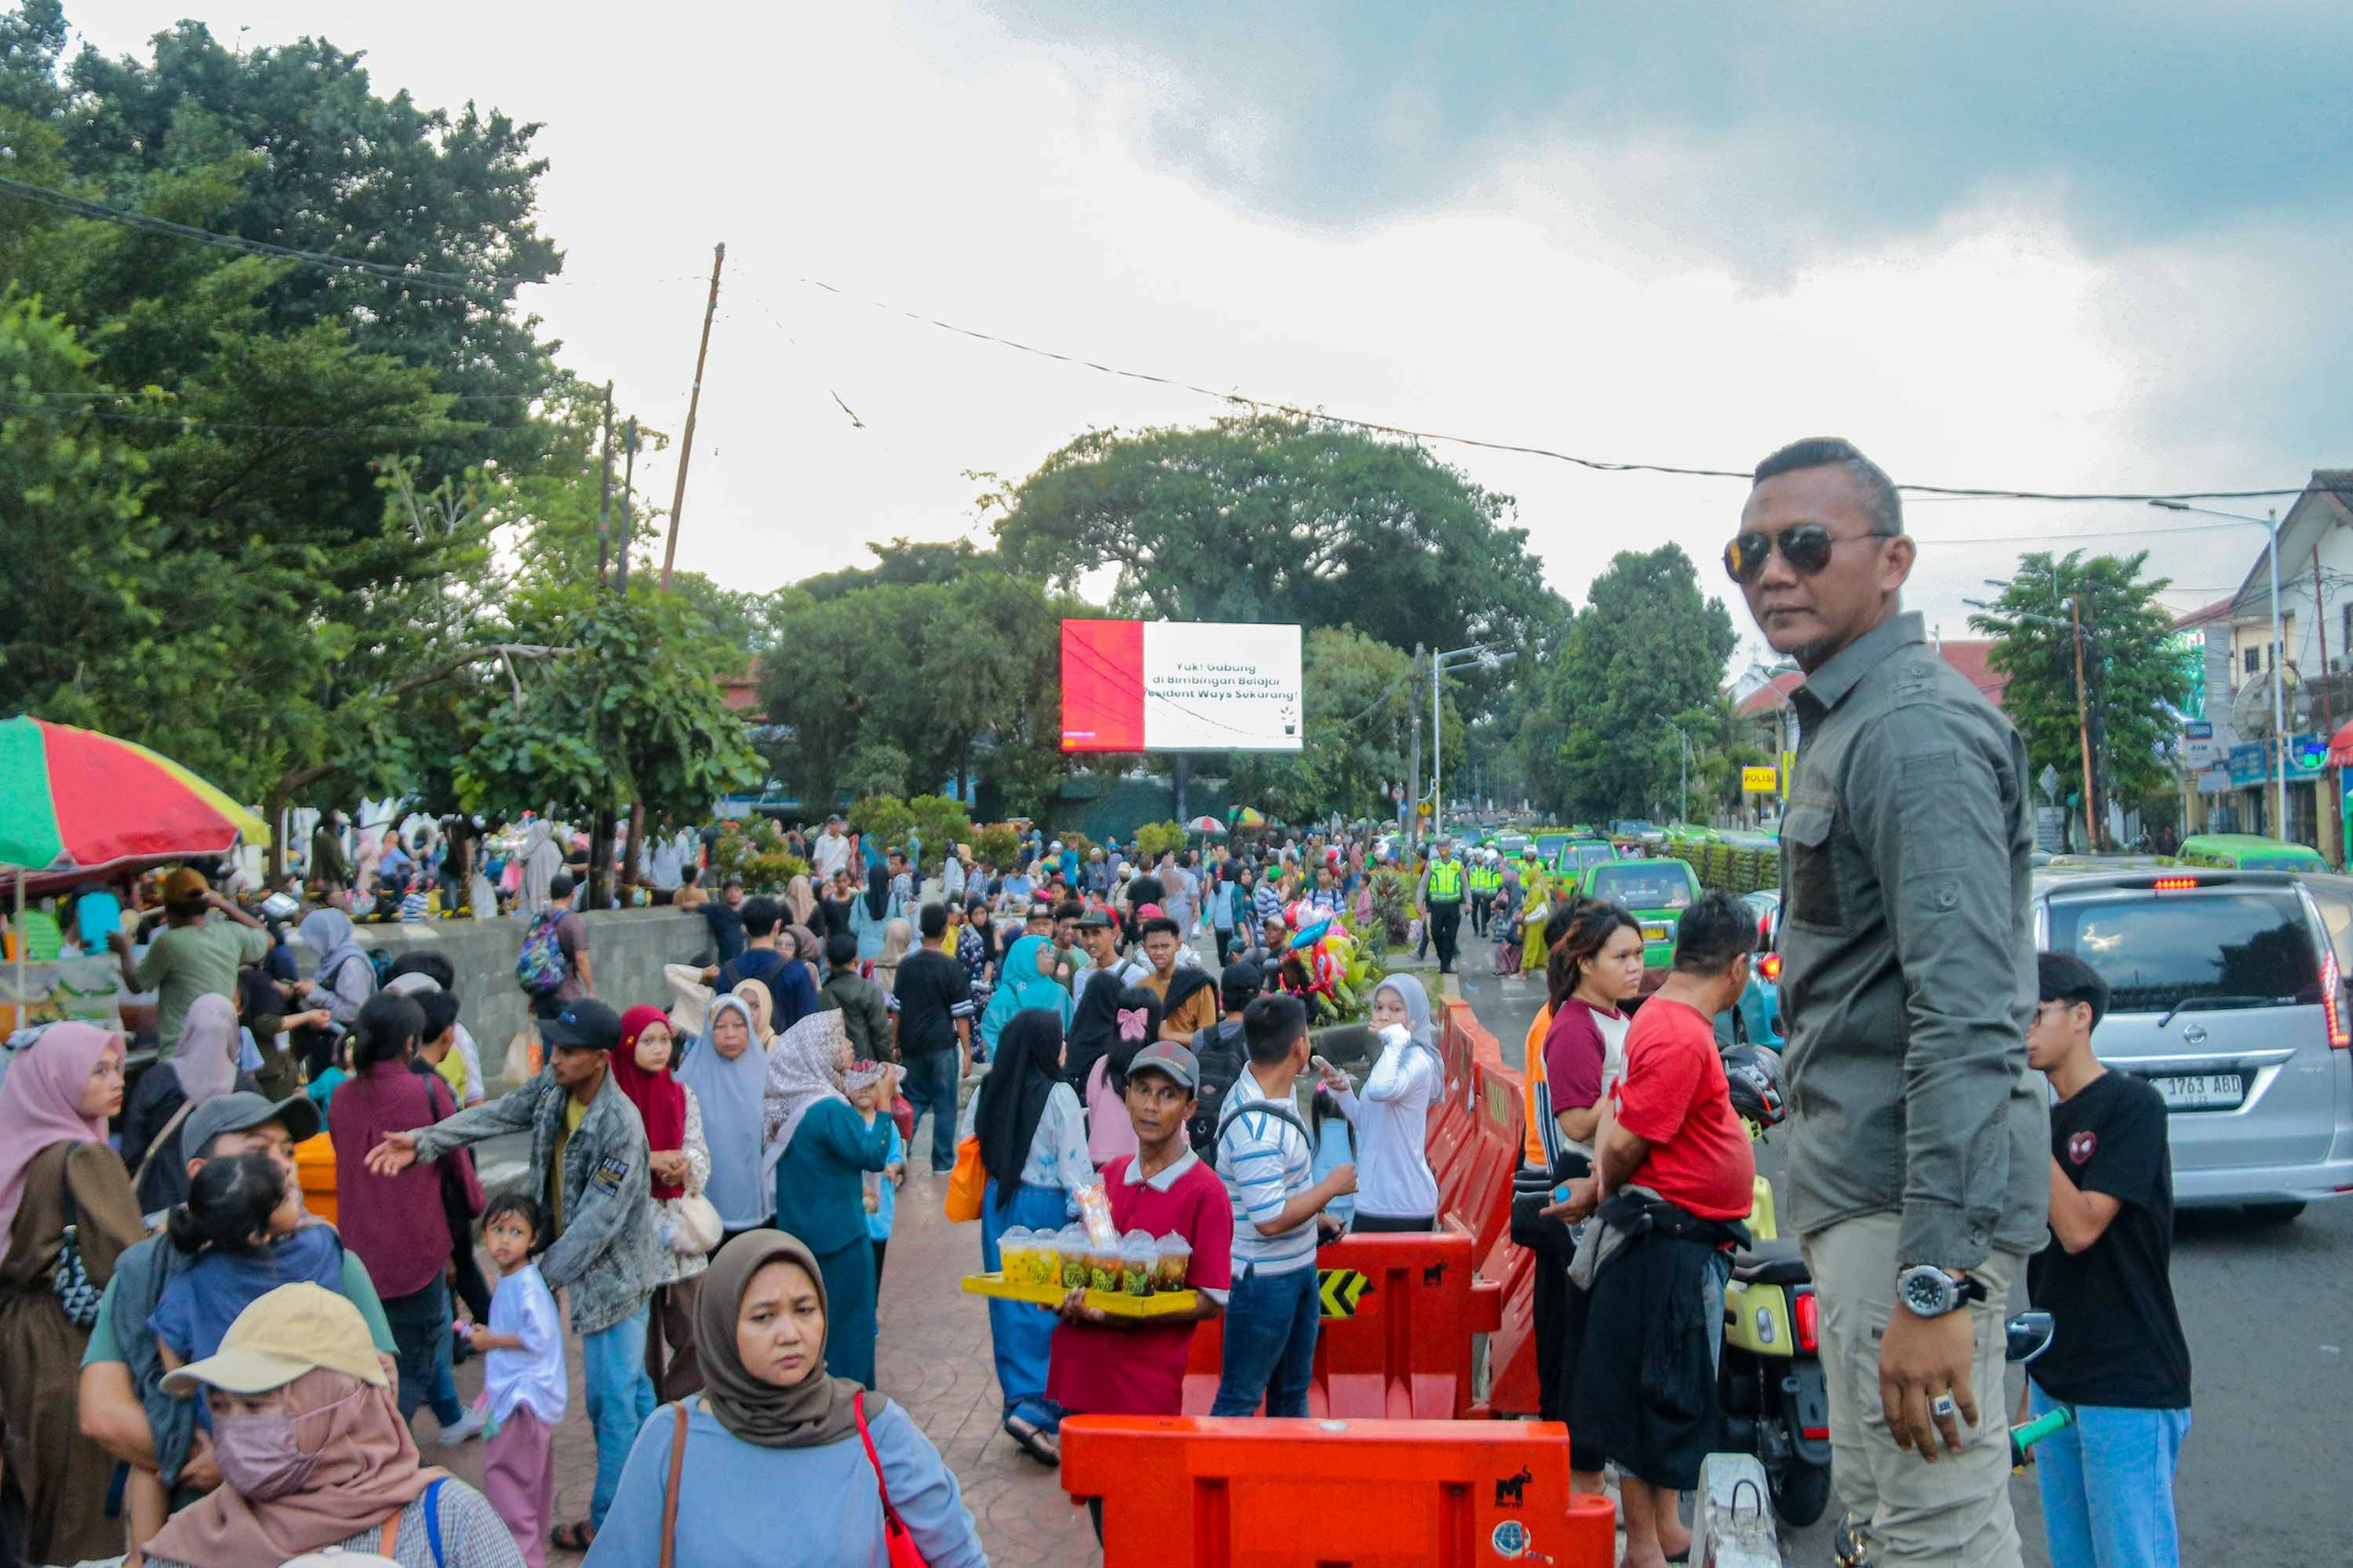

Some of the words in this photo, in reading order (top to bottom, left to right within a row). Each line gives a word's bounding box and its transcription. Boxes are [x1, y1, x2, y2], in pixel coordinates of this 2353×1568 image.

[1207, 662, 1256, 675] Gabung
[1167, 676, 1235, 687] Bimbingan
[1238, 676, 1279, 687] Belajar
[1198, 689, 1232, 700] Ways
[1235, 689, 1298, 701] Sekarang!
[1745, 773, 1775, 782] POLISI
[2168, 1076, 2205, 1095] 1763
[2213, 1074, 2240, 1093] ABD
